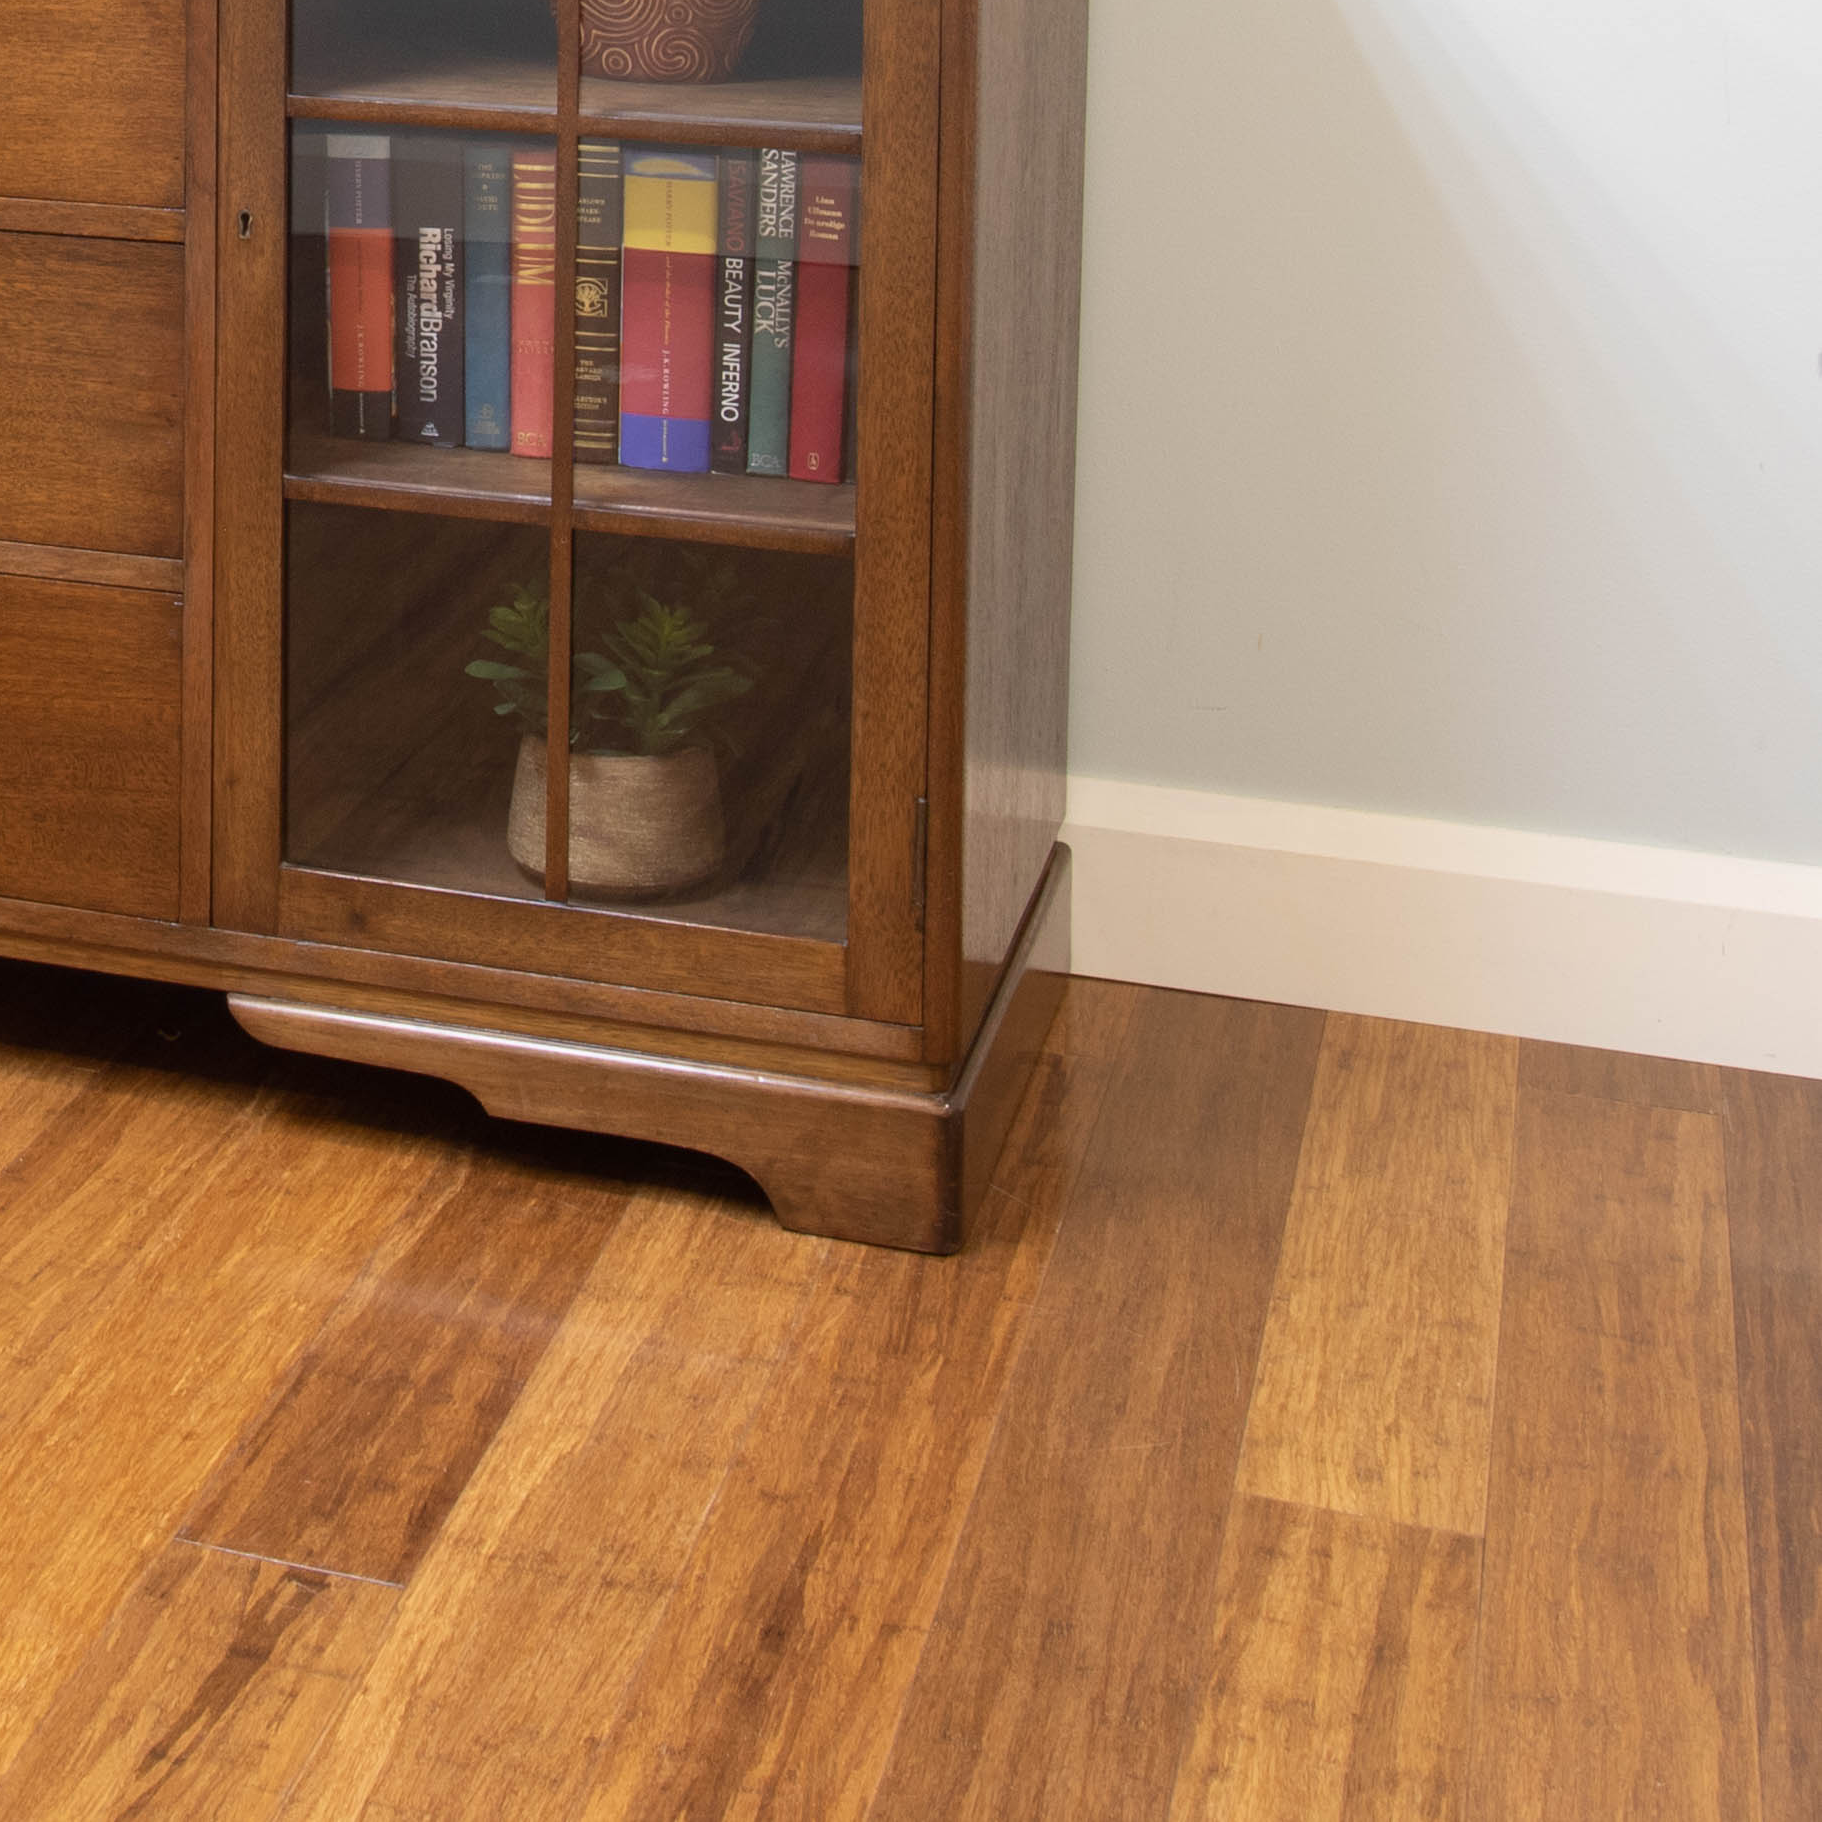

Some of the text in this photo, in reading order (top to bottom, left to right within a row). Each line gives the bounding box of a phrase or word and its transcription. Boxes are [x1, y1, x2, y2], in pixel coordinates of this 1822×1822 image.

[513, 163, 554, 285] LUDLUM
[727, 162, 745, 252] SAVIANO
[759, 148, 779, 238] SANDERS
[778, 151, 796, 240] LAWRENCE
[405, 274, 417, 358] The Autobiography
[419, 228, 443, 402] RichardBranson
[441, 228, 455, 319] Losing My Virginity
[754, 270, 777, 335] LUCK
[774, 260, 793, 349] McNALLY'S
[720, 258, 743, 422] BEAUTY INFERNO
